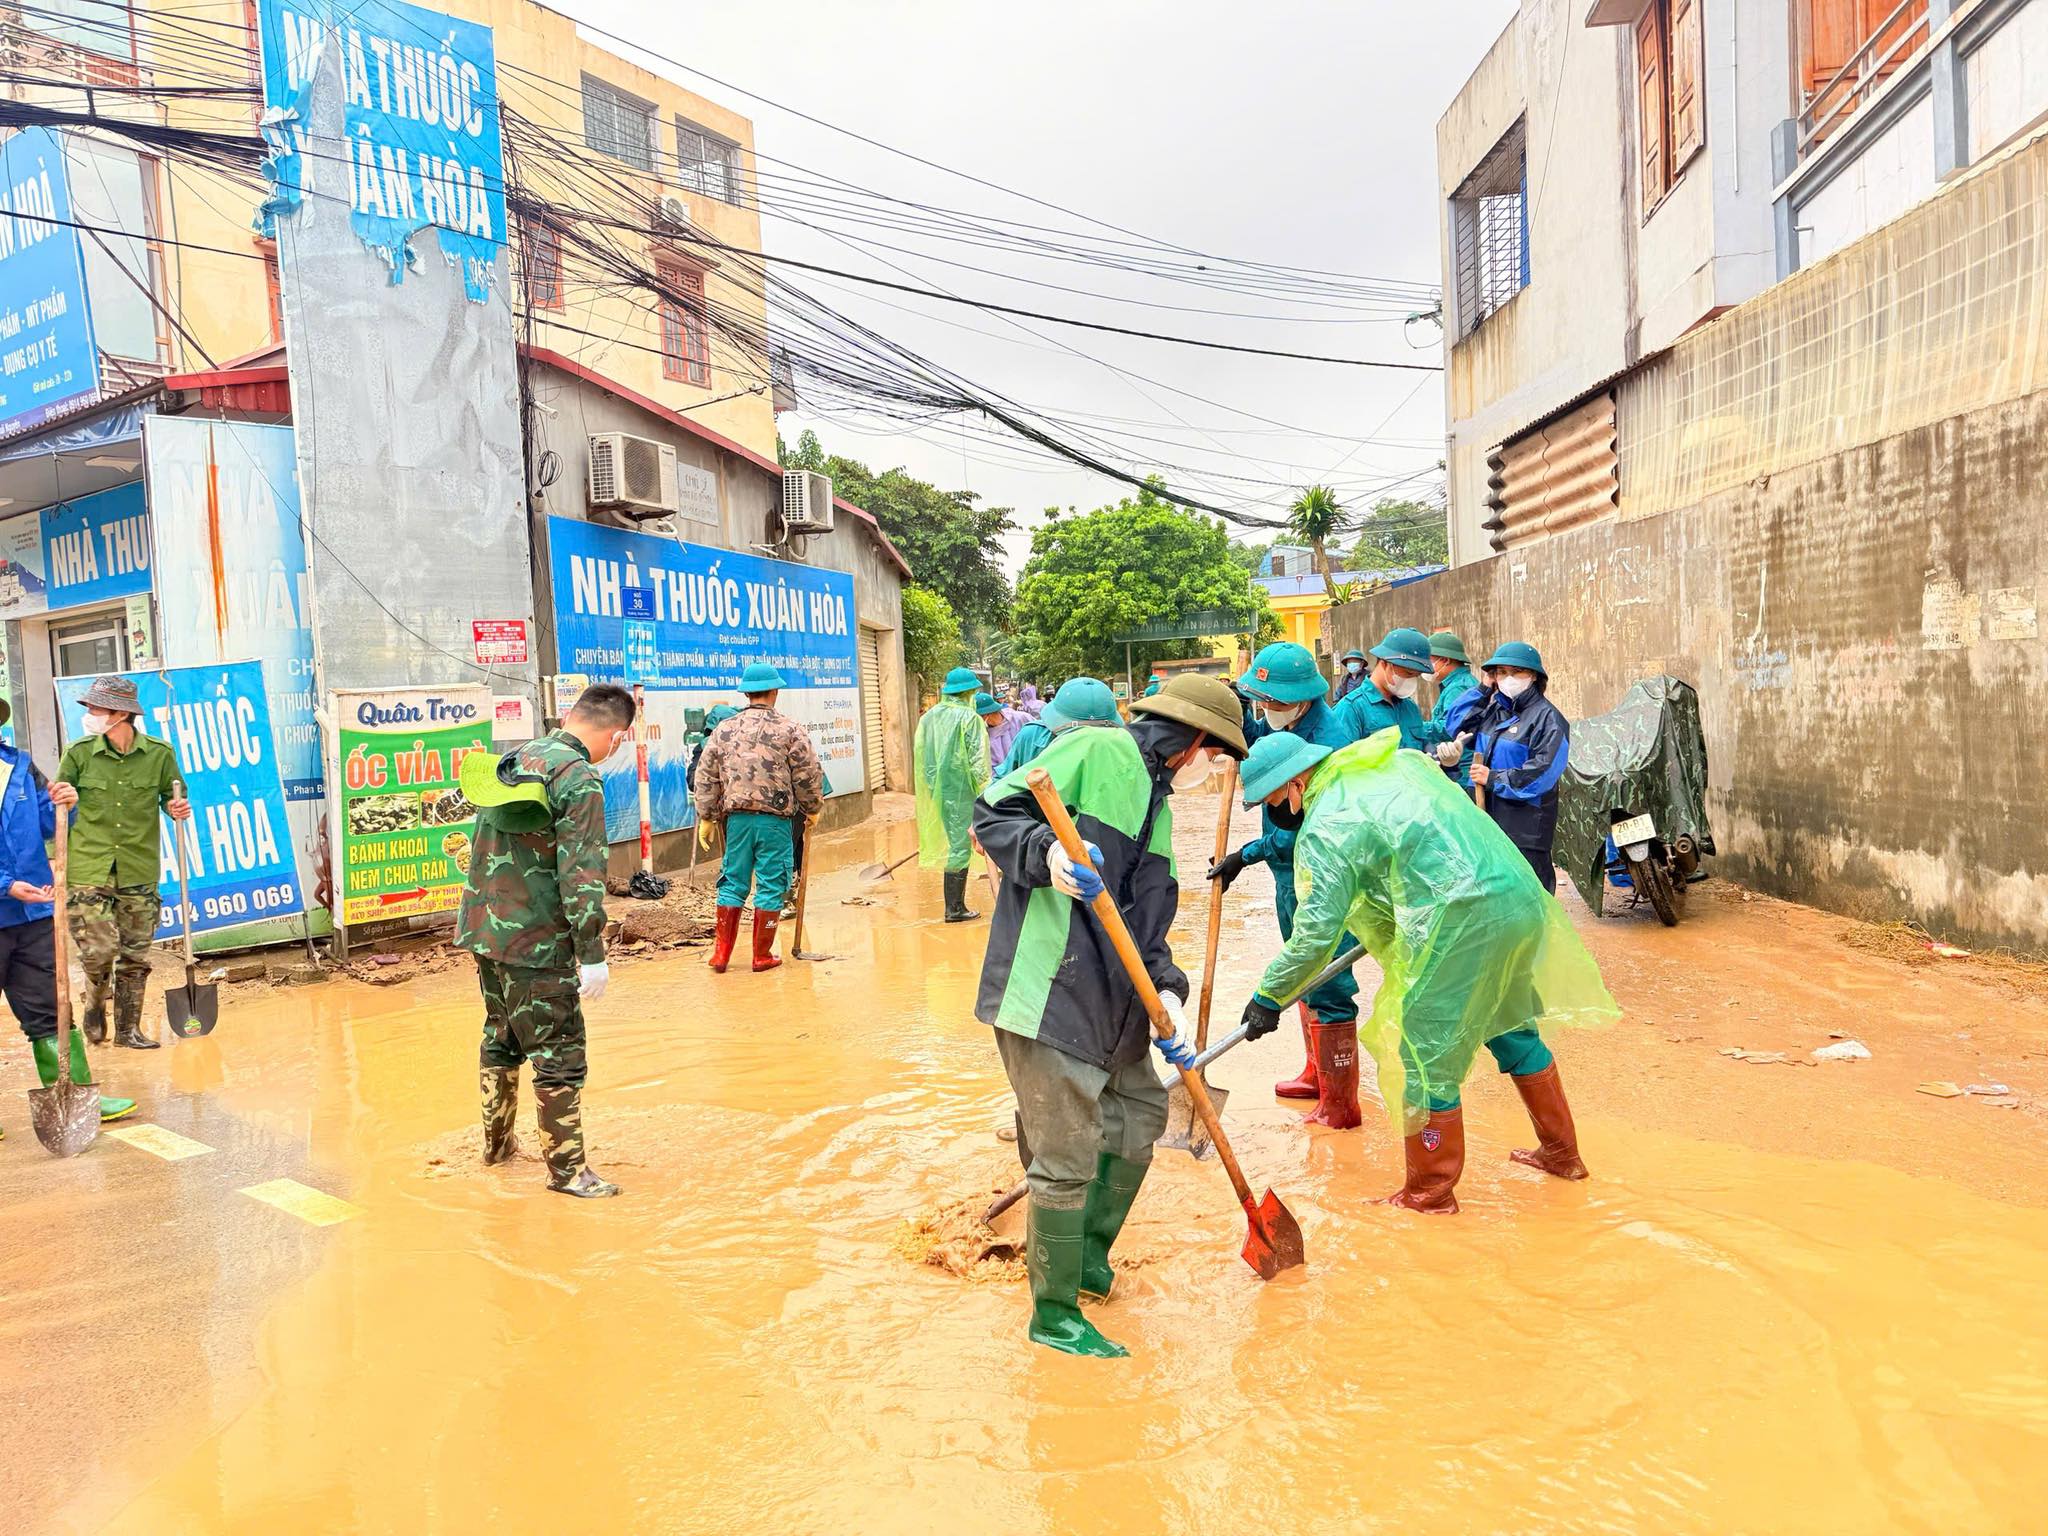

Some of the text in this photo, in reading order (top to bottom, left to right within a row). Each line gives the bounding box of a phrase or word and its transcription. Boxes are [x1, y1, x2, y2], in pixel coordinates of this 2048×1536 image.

[370, 29, 484, 138] THUỐC
[419, 140, 493, 241] HÒA
[40, 285, 67, 323] PHẨM
[3, 348, 27, 378] DỤNG
[38, 339, 46, 362] Y
[45, 327, 59, 359] TẾ
[50, 517, 100, 589] NHÀ
[633, 598, 643, 609] 30
[650, 560, 740, 628] THUỐC
[745, 577, 806, 635] XUÂN
[810, 583, 848, 636] HÒA
[575, 646, 608, 666] CHUYÊN
[663, 649, 684, 667] THÀNH
[686, 648, 705, 668] PHẨM
[709, 651, 719, 668] MỸ
[720, 649, 737, 669] PHẨM
[748, 636, 759, 645] GPP
[153, 672, 262, 775] THUỐC
[357, 701, 424, 728] Quân
[426, 698, 478, 724] Trọc
[346, 743, 388, 791] ỐC
[394, 740, 444, 786] VỈA
[293, 783, 315, 795] Phan
[206, 783, 280, 875] HÒA
[349, 837, 428, 865] BÁNH KHOAI
[350, 857, 448, 891] NEM CHUA RÁN
[204, 891, 247, 920] 960
[252, 883, 295, 912] 069
